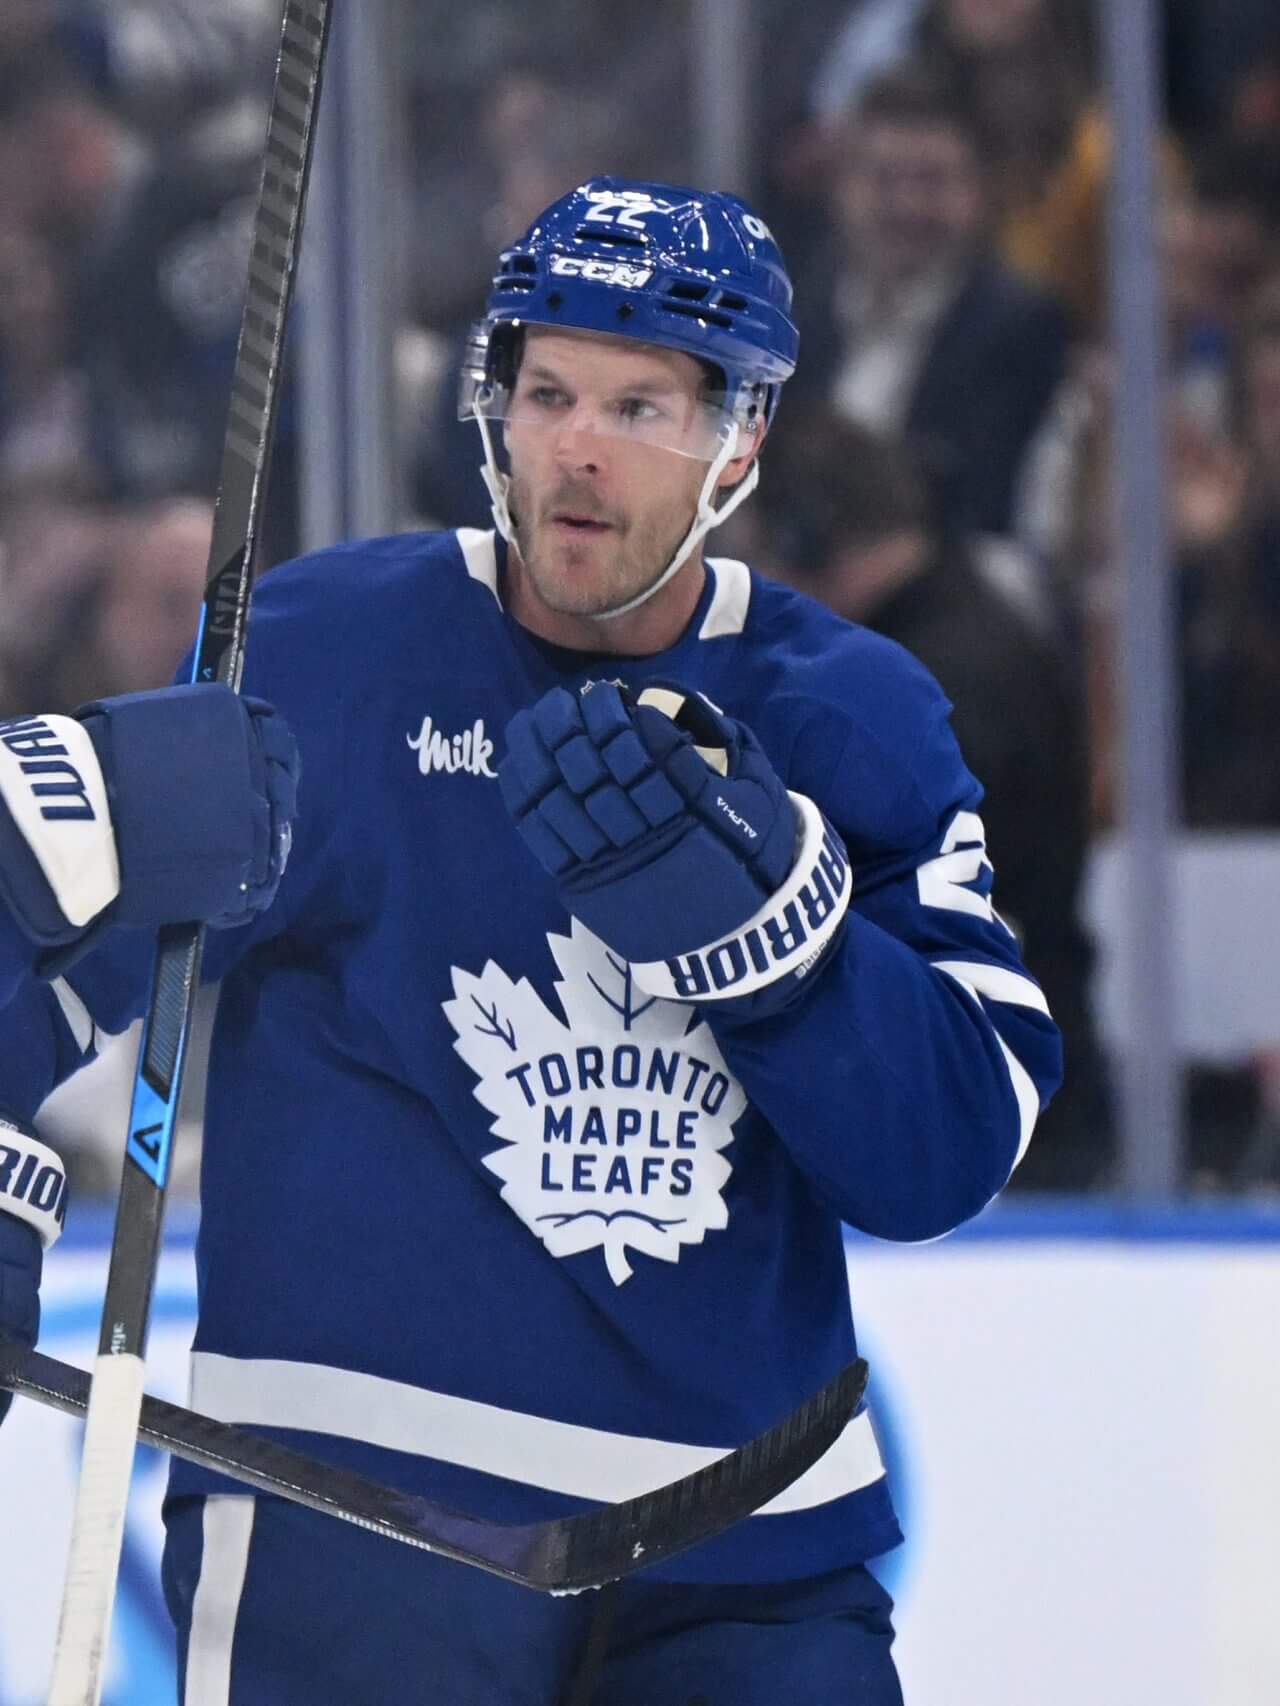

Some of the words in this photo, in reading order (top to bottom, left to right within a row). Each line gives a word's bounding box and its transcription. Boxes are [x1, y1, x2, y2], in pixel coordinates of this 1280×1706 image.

[584, 191, 657, 230] 22
[551, 256, 654, 289] CCM
[406, 715, 500, 779] Milk
[716, 796, 759, 839] ALPHA
[505, 1044, 729, 1117] TORONTO
[543, 1104, 700, 1149] MAPLE
[540, 1152, 694, 1196] LEAFS
